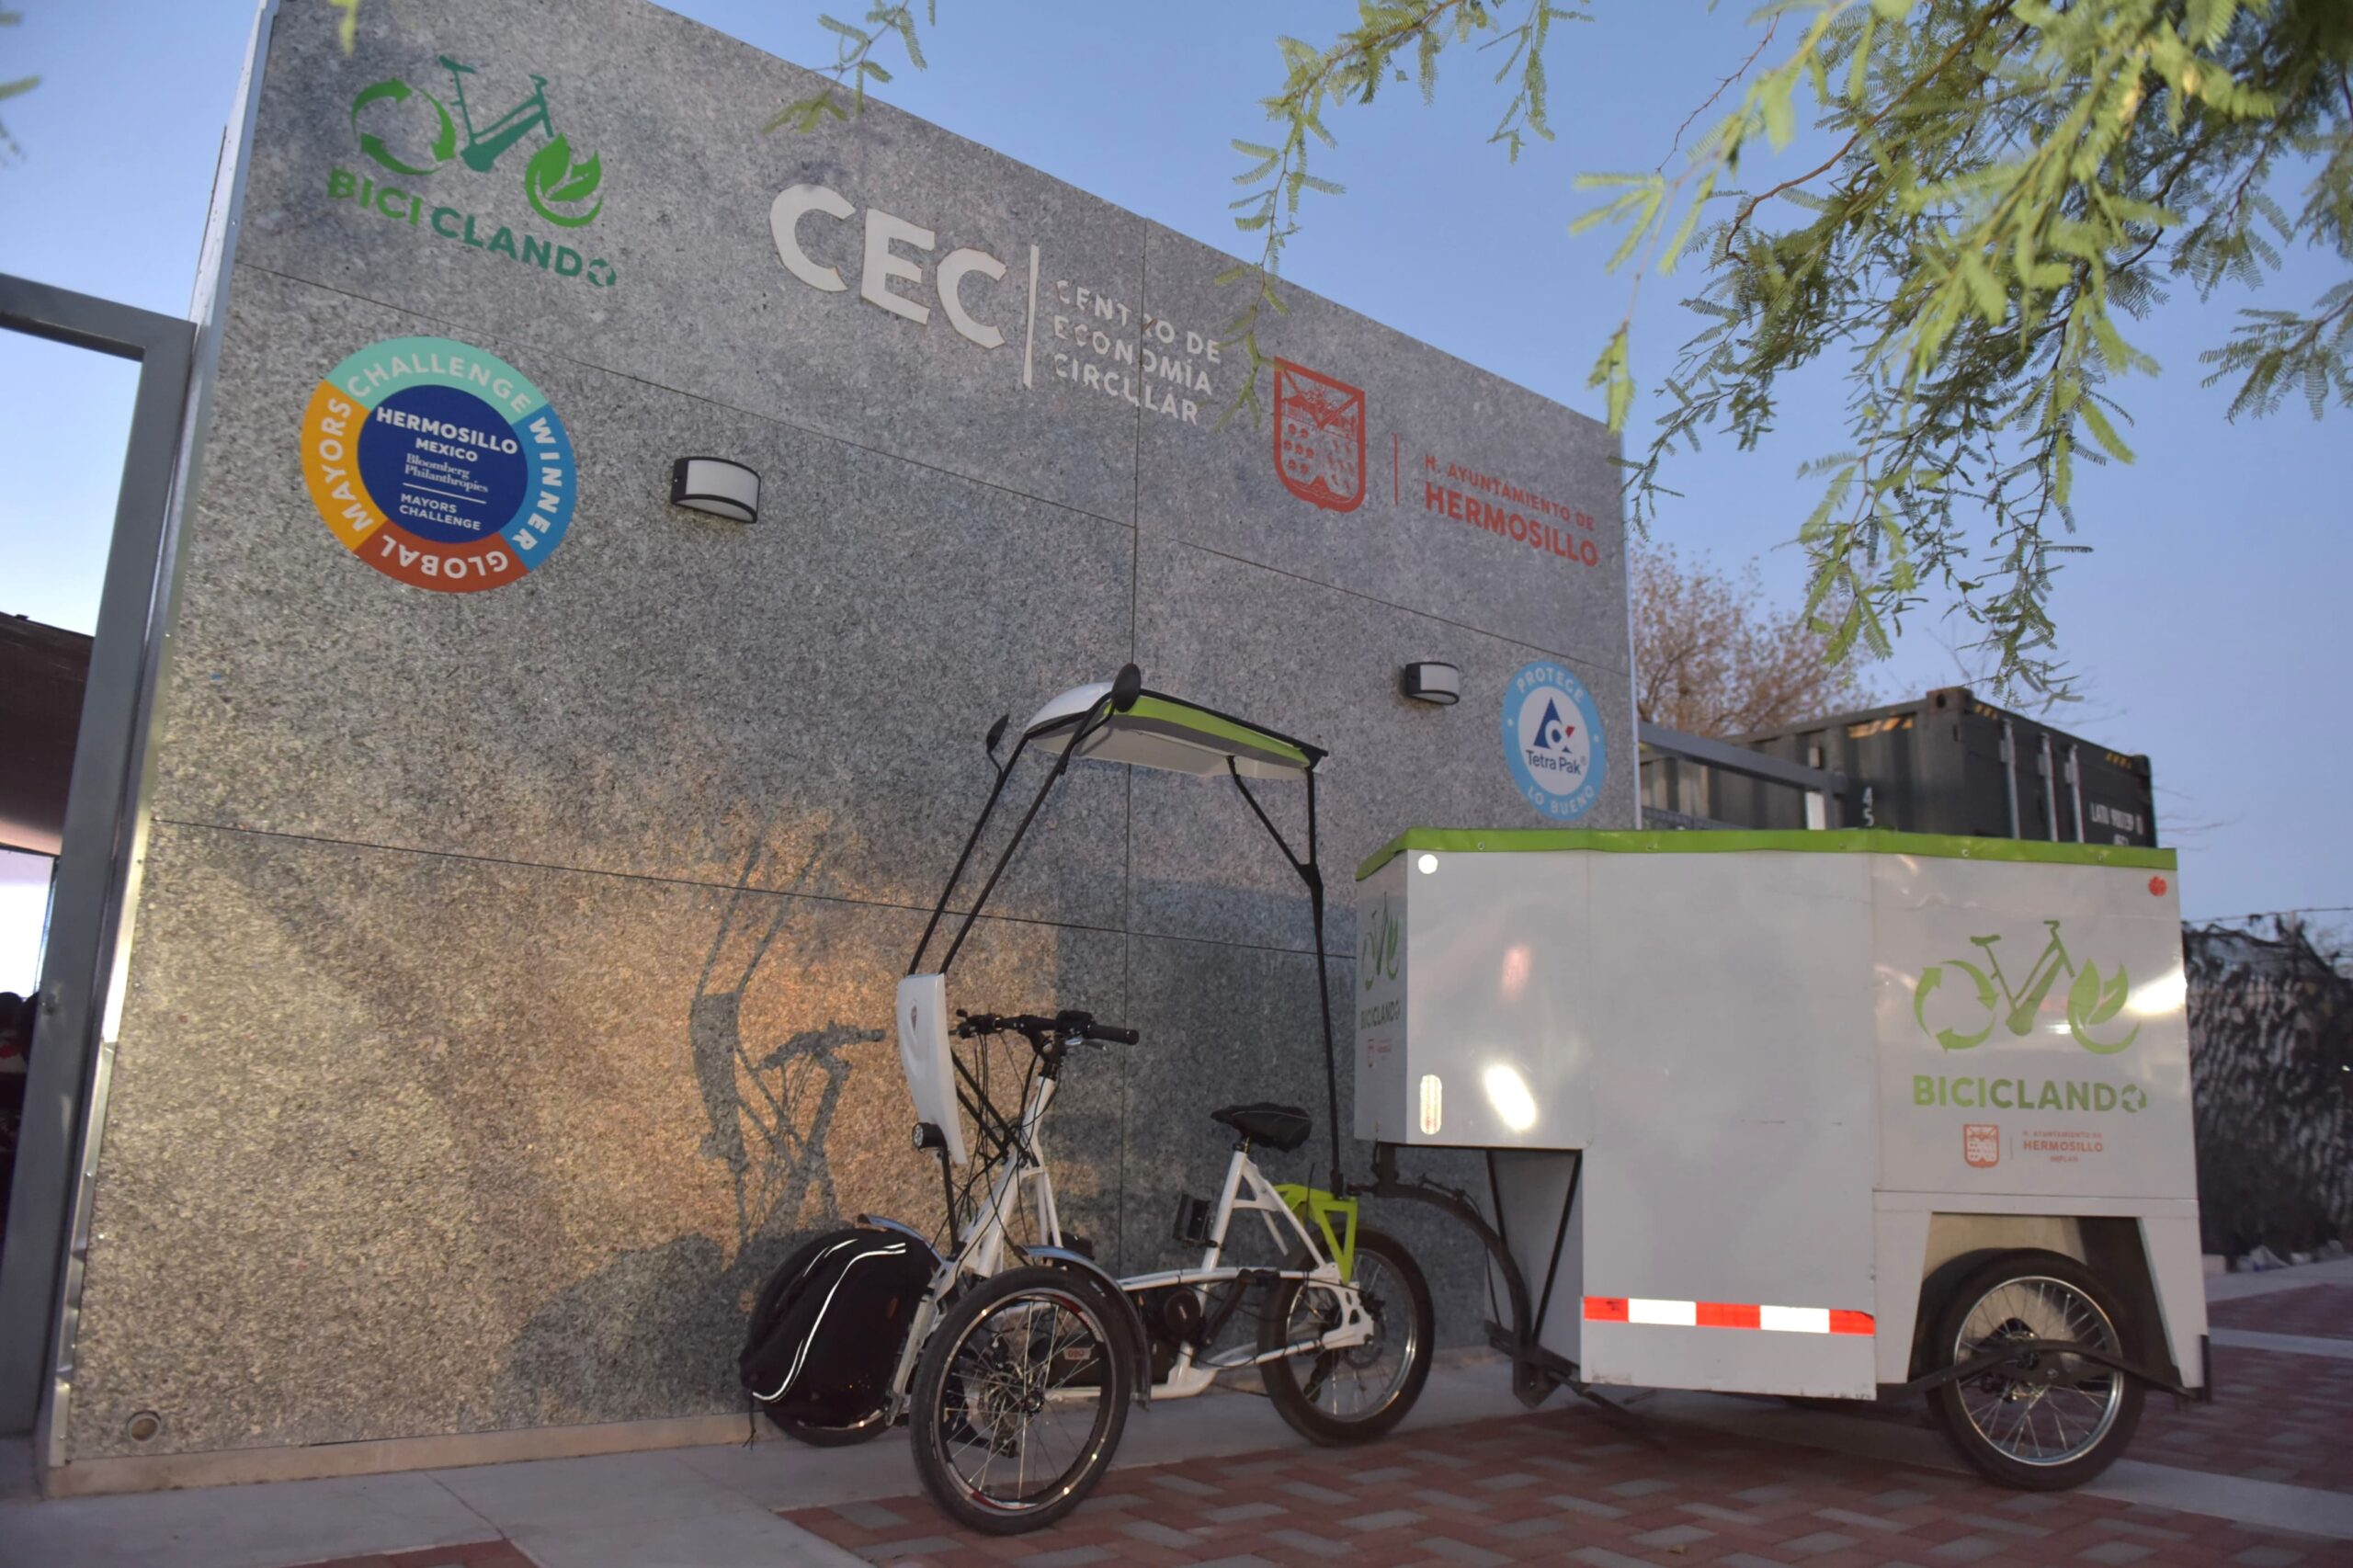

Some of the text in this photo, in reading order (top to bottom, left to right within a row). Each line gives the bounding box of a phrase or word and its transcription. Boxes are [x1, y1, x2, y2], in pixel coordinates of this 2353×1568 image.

[769, 183, 1006, 349] CEC
[1054, 314, 1212, 395] ECONOMÍA
[1187, 331, 1221, 364] DE
[1054, 354, 1198, 426] CIRCULAR
[376, 406, 518, 455] HERMOSILLO
[415, 437, 478, 461] MEXICO
[318, 353, 563, 579] GLOBAL MAYORS CHALLENGE WINNER
[404, 463, 489, 493] Philanthropies
[405, 453, 470, 480] Bloomberg
[401, 493, 457, 514] MAYORS
[1425, 452, 1595, 531] H. AYUNTAMIENTO DE
[399, 505, 482, 530] CHALLENGE
[1425, 481, 1599, 567] HERMOSILLO
[1526, 749, 1581, 776] Tetra Pak
[1528, 785, 1595, 815] LO BUENO
[1913, 1074, 2147, 1113] BICICLANDO
[2023, 1141, 2103, 1153] HERMOSILLO
